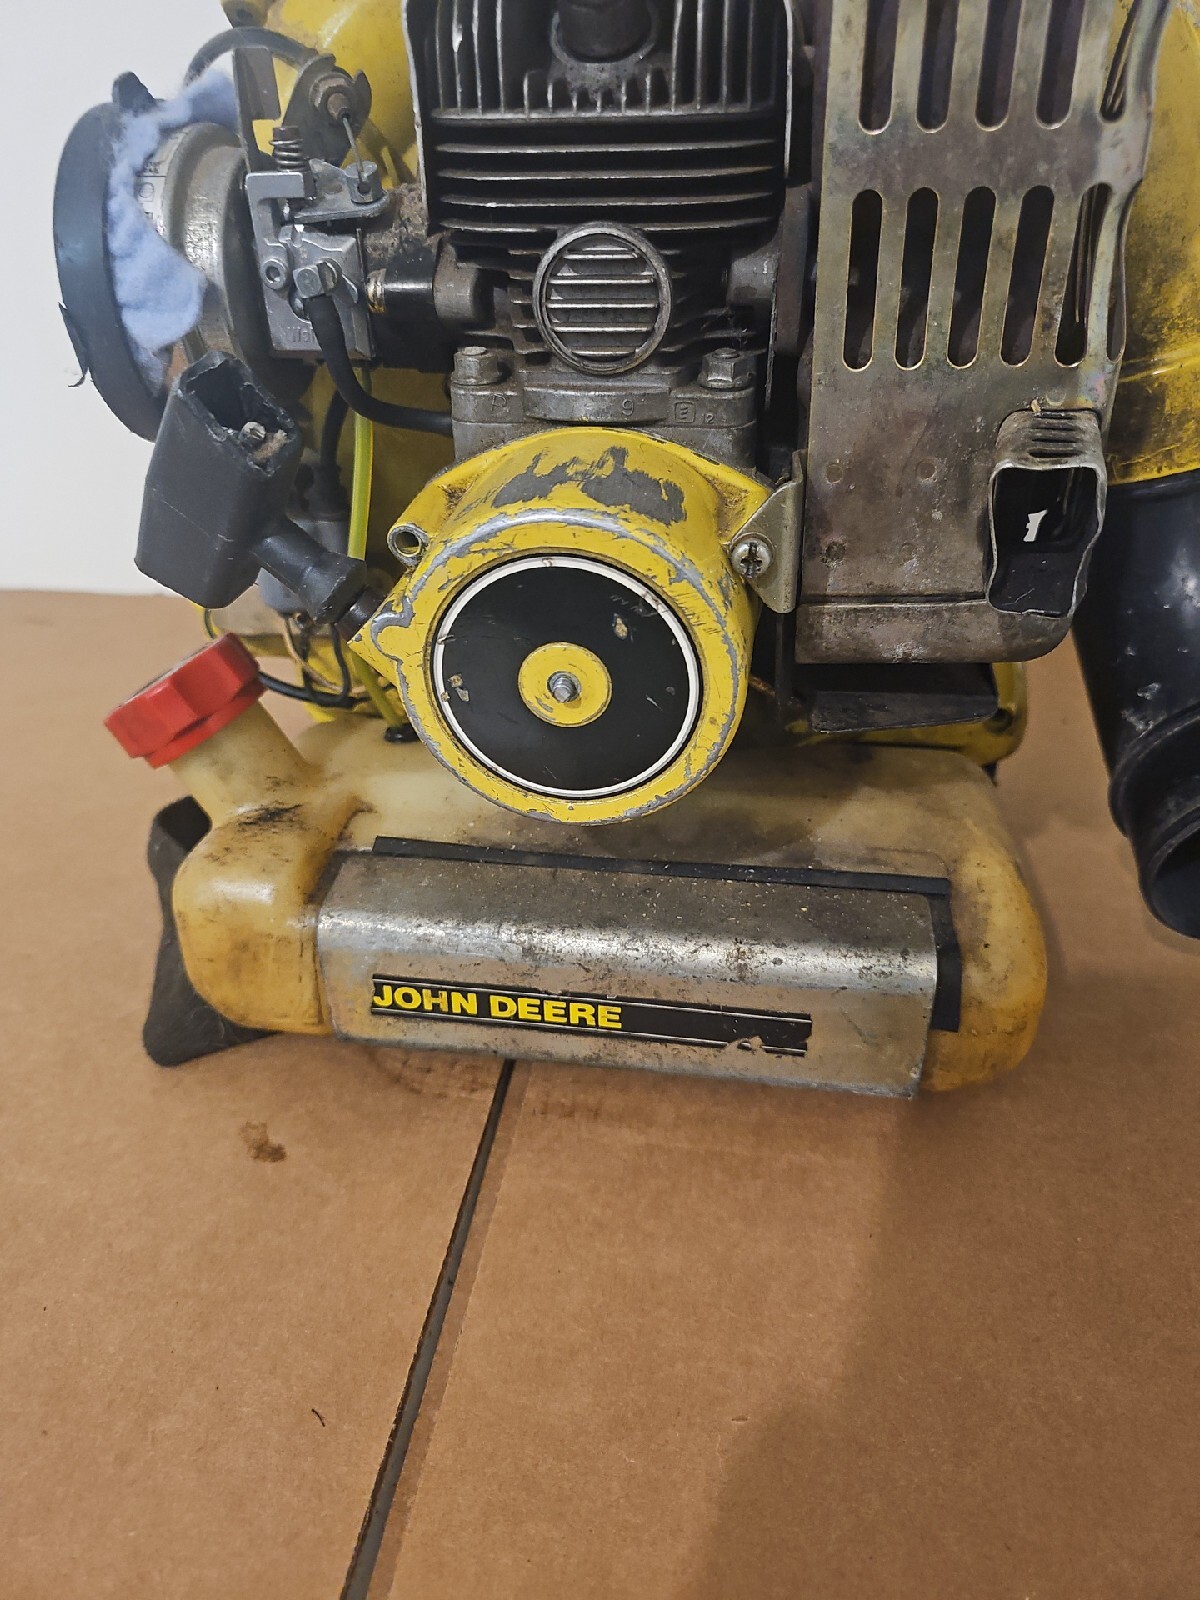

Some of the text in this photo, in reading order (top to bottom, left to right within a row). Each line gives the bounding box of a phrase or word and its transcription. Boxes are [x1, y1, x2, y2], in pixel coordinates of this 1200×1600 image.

[622, 399, 635, 416] 9
[373, 986, 622, 1030] JOHN DEERE
